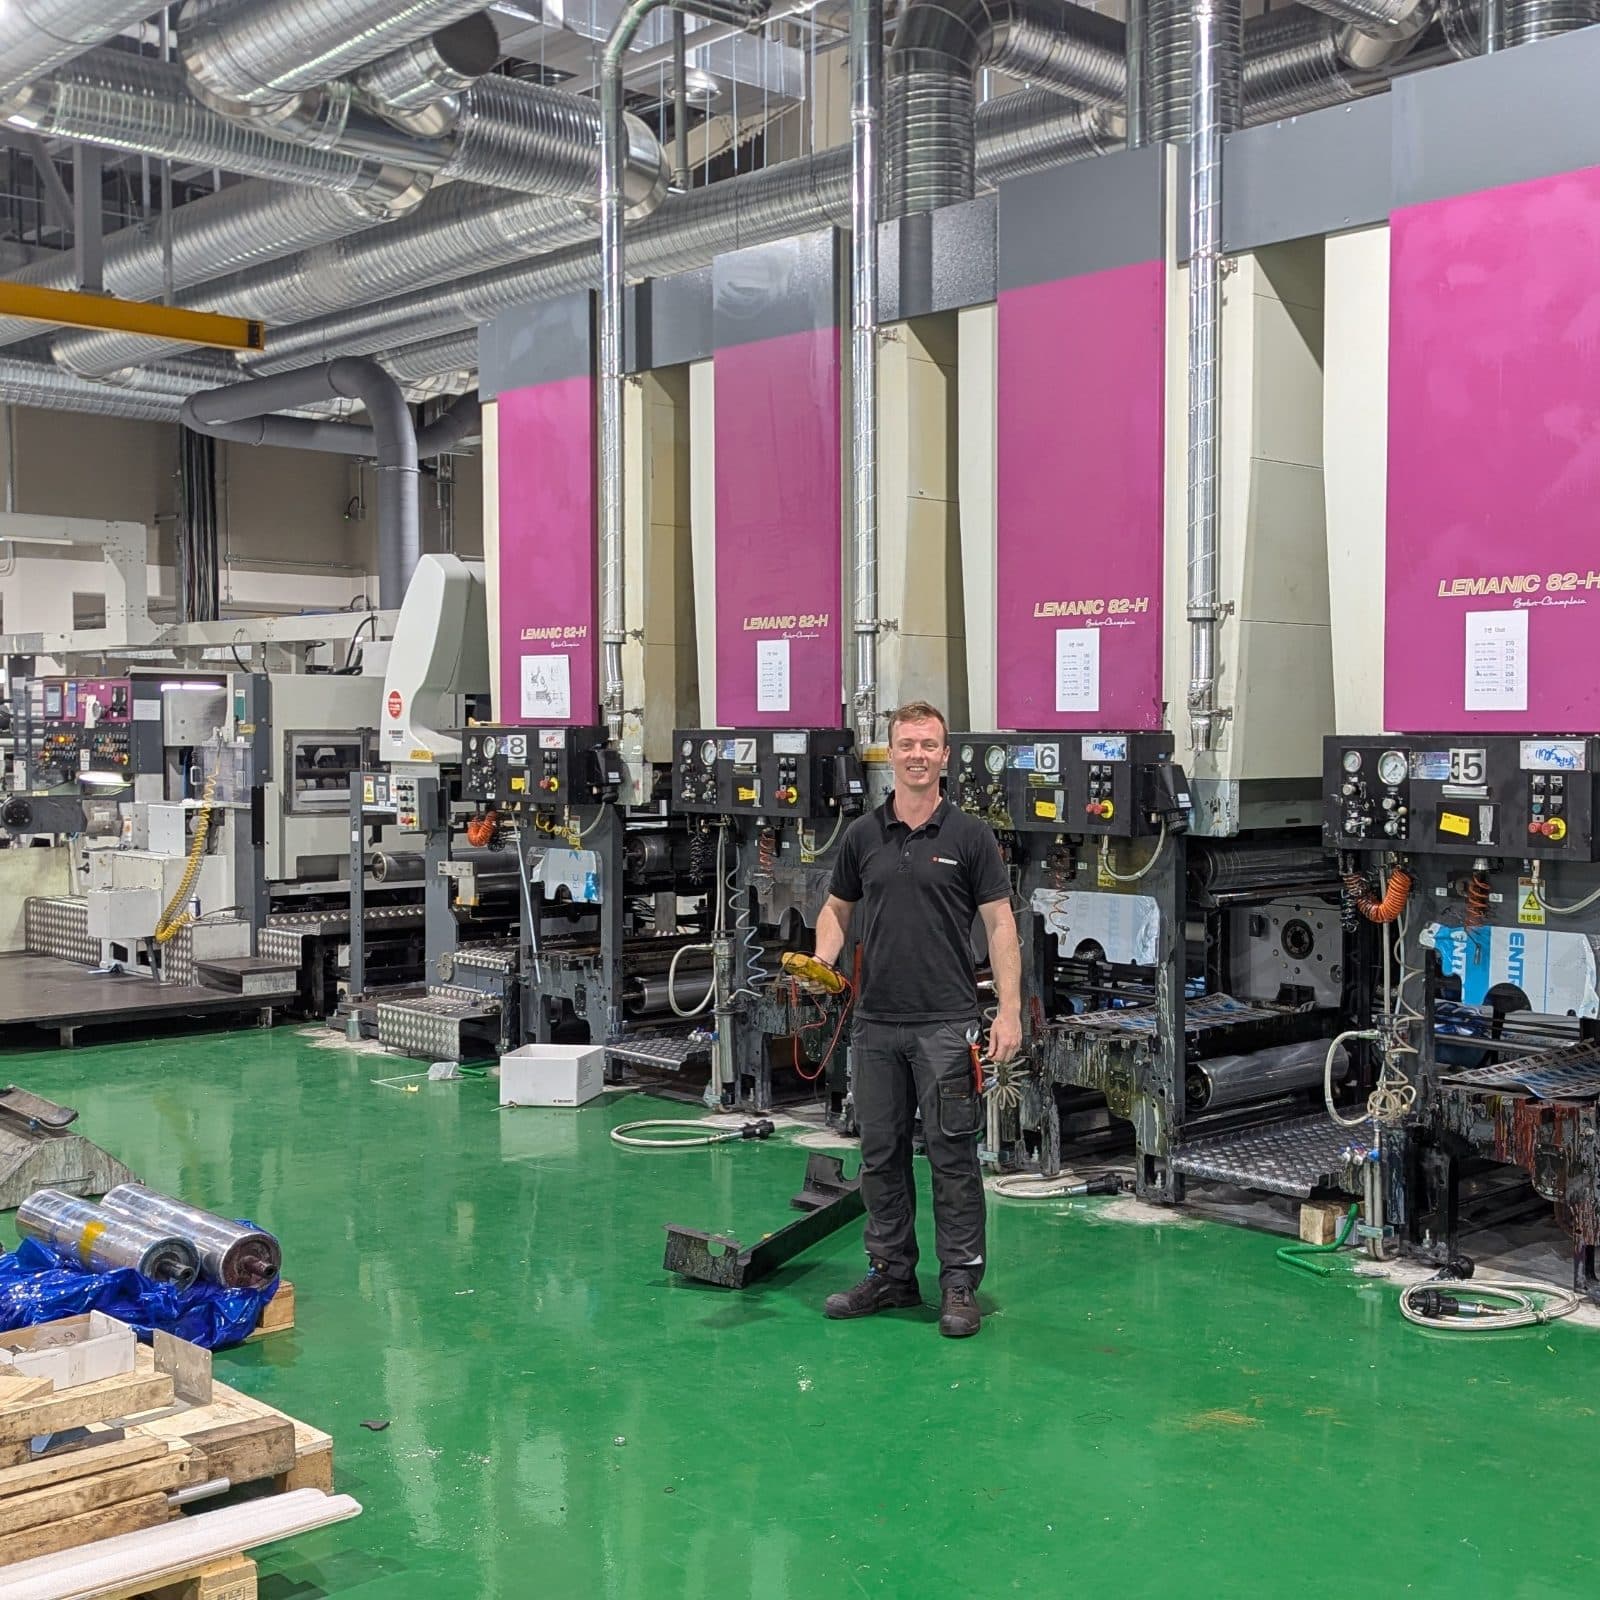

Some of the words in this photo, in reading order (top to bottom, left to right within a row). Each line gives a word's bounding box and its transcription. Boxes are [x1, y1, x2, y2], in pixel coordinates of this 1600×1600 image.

[1438, 574, 1541, 597] LEMANIC
[1546, 571, 1600, 592] 82-H
[1034, 599, 1104, 617] LEMANIC
[1108, 597, 1149, 614] 82-H
[743, 615, 796, 630] LEMANIC
[799, 614, 829, 628] 82-H
[520, 626, 562, 640] LEMANIC
[563, 625, 587, 639] 82-H
[510, 737, 524, 755] 8
[737, 741, 753, 761] 7
